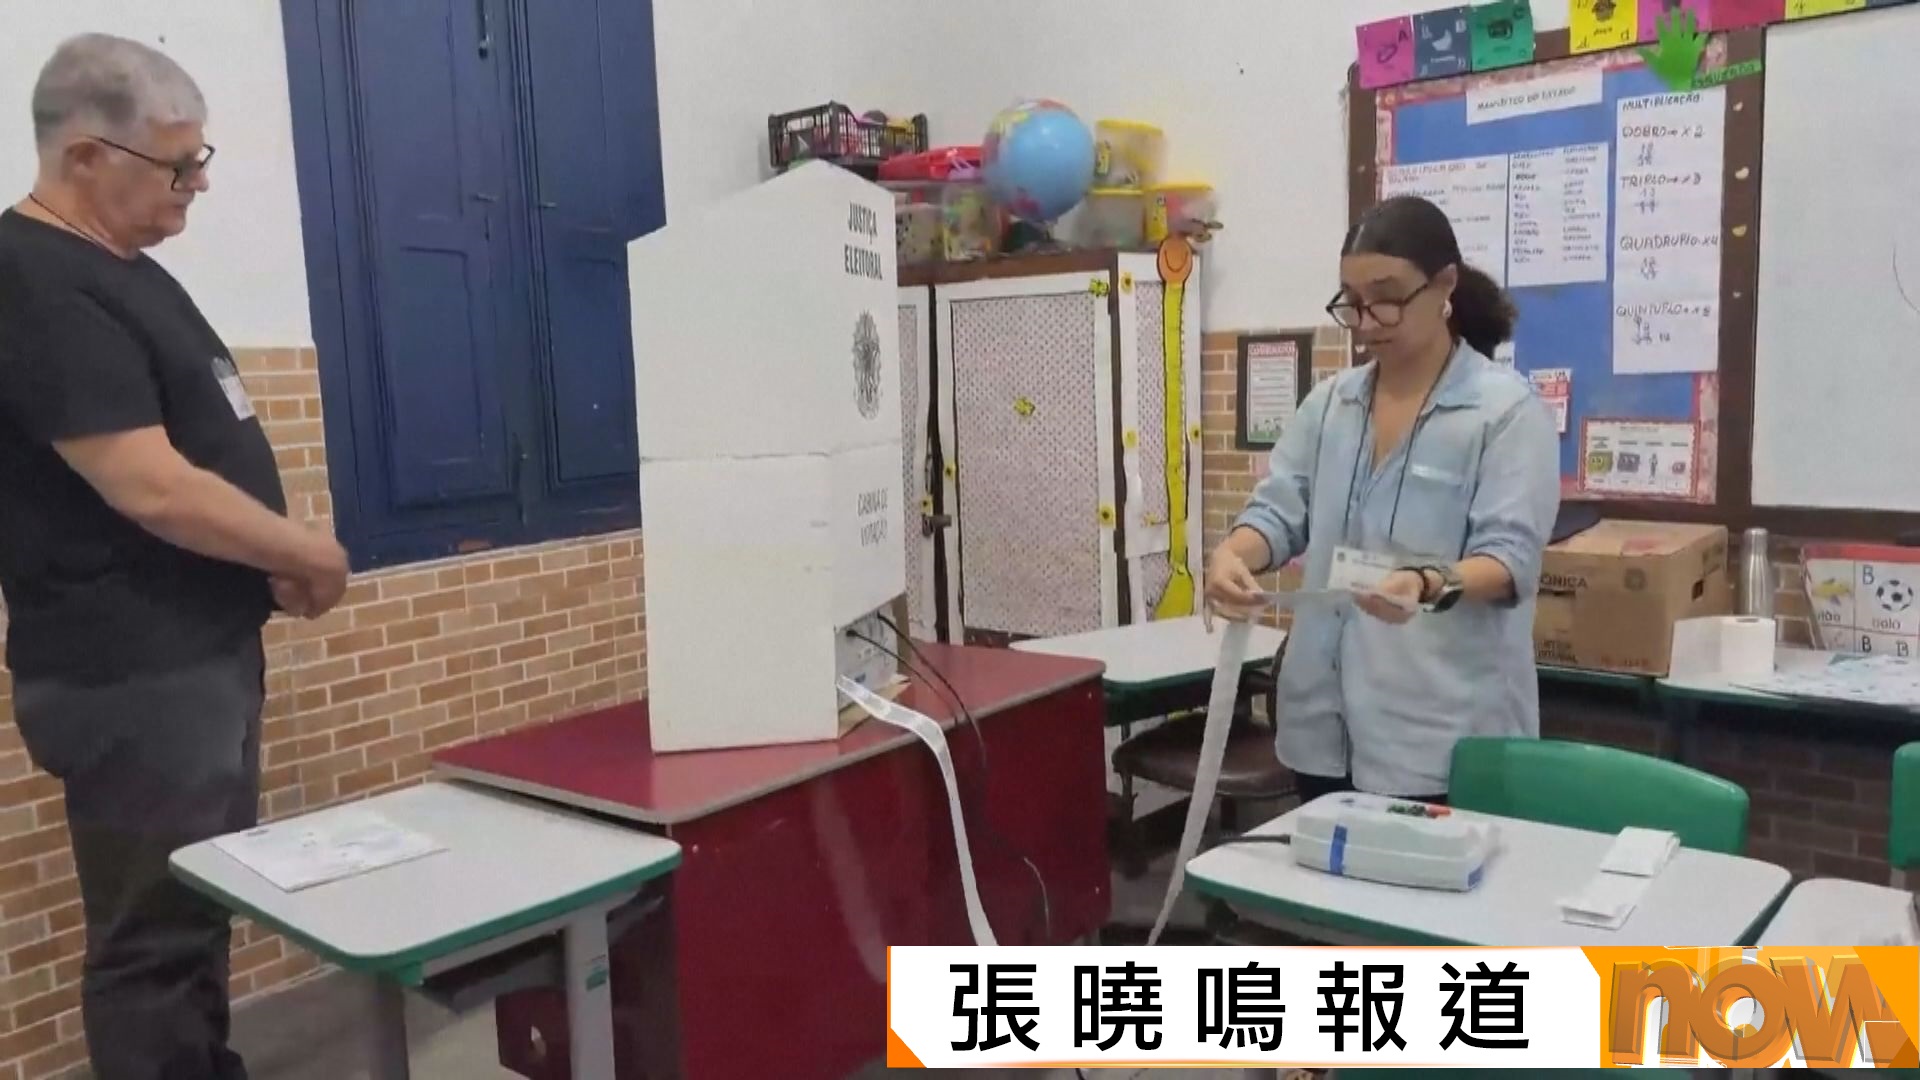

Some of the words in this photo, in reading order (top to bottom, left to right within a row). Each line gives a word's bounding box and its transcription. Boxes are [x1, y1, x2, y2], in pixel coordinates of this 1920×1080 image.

[1621, 125, 1667, 139] DOBRO
[1621, 173, 1667, 189] TRIPLO
[848, 201, 878, 244] JUSTIÇA
[844, 243, 883, 281] ELEITORAL
[1862, 564, 1875, 585] B
[1861, 634, 1873, 654] B
